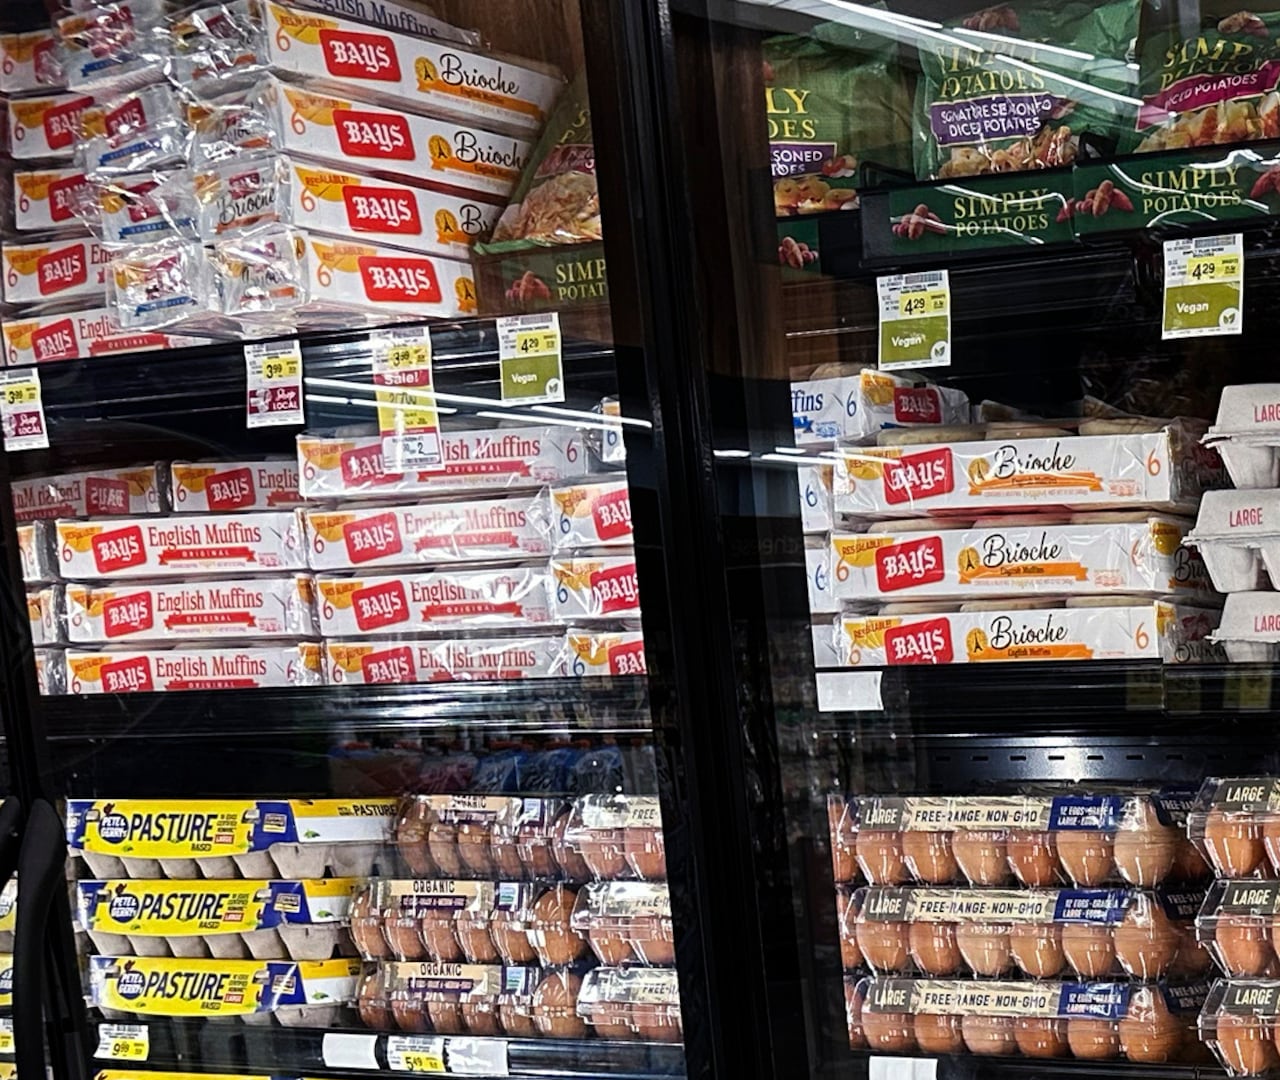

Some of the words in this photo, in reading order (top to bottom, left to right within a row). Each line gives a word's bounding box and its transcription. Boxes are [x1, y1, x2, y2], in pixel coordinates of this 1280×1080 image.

[329, 39, 391, 74] BAYS
[441, 53, 520, 95] Brioche
[1141, 166, 1239, 195] SIMPLY
[954, 188, 1048, 219] SIMPLY
[1143, 189, 1241, 214] POTATOES
[955, 214, 1048, 237] POTATOES
[1176, 300, 1208, 314] Vegan
[511, 372, 538, 384] Vegan
[99, 535, 140, 560] BAYS
[149, 525, 198, 548] English
[203, 523, 261, 545] Muffins
[883, 546, 936, 578] BAYS
[983, 532, 1061, 567] Brioche
[1135, 621, 1149, 649] 6
[129, 812, 214, 843] PASTURE
[865, 808, 897, 824] LARGE
[986, 809, 1037, 823] NON-GMO
[413, 880, 456, 894] ORGANIC
[1232, 889, 1271, 905] LARGE
